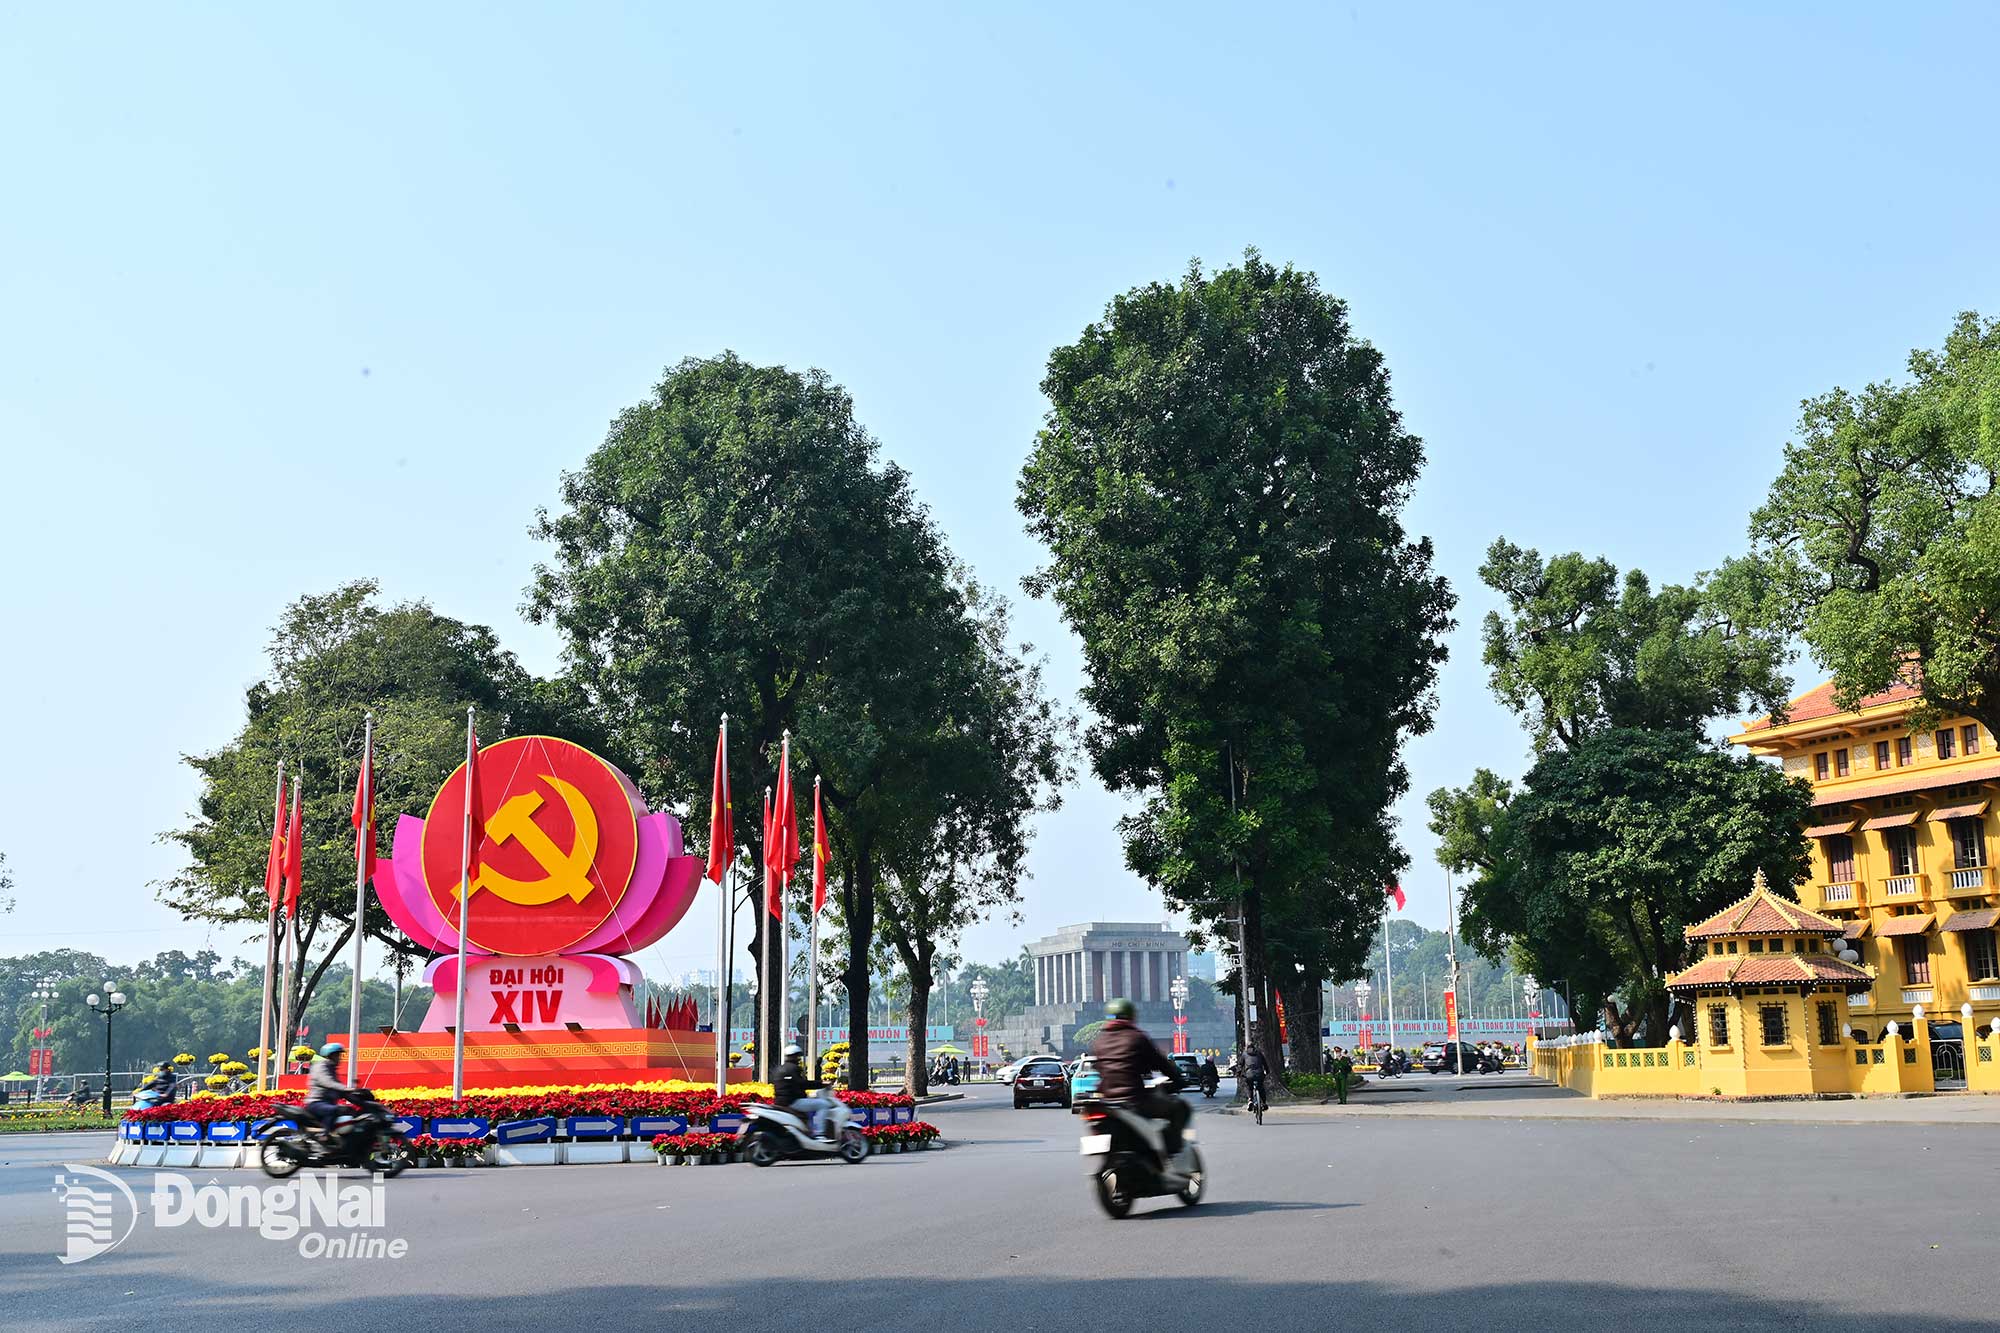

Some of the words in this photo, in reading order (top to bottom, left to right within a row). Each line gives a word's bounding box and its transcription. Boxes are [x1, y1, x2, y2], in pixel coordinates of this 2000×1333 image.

[489, 969, 523, 988] ĐẠI
[530, 965, 564, 988] HỘI
[489, 990, 563, 1024] XIV
[868, 1028, 900, 1039] MUÔN
[1403, 1023, 1420, 1031] MINH
[1482, 1021, 1504, 1030] TRONG
